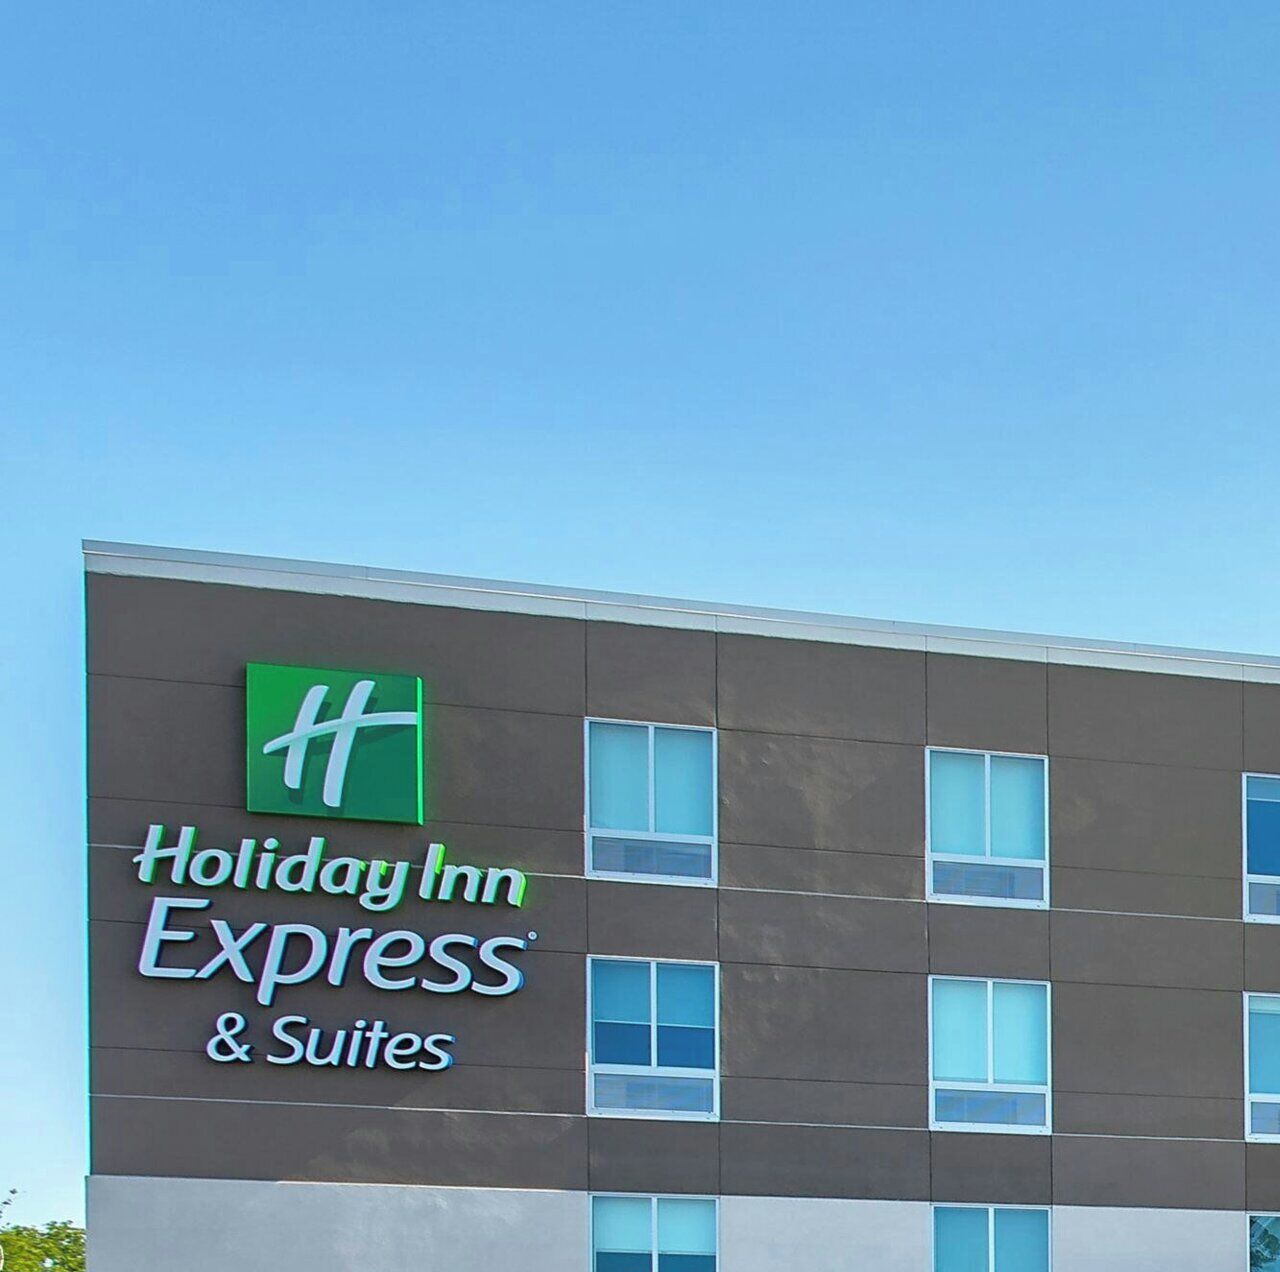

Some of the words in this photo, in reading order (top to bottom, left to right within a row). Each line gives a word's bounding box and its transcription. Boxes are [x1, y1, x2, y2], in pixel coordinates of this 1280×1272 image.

[132, 824, 409, 912] Holiday
[419, 843, 526, 907] Inn
[137, 896, 529, 1007] Express
[206, 1011, 253, 1063] &
[266, 1015, 456, 1071] Suites
